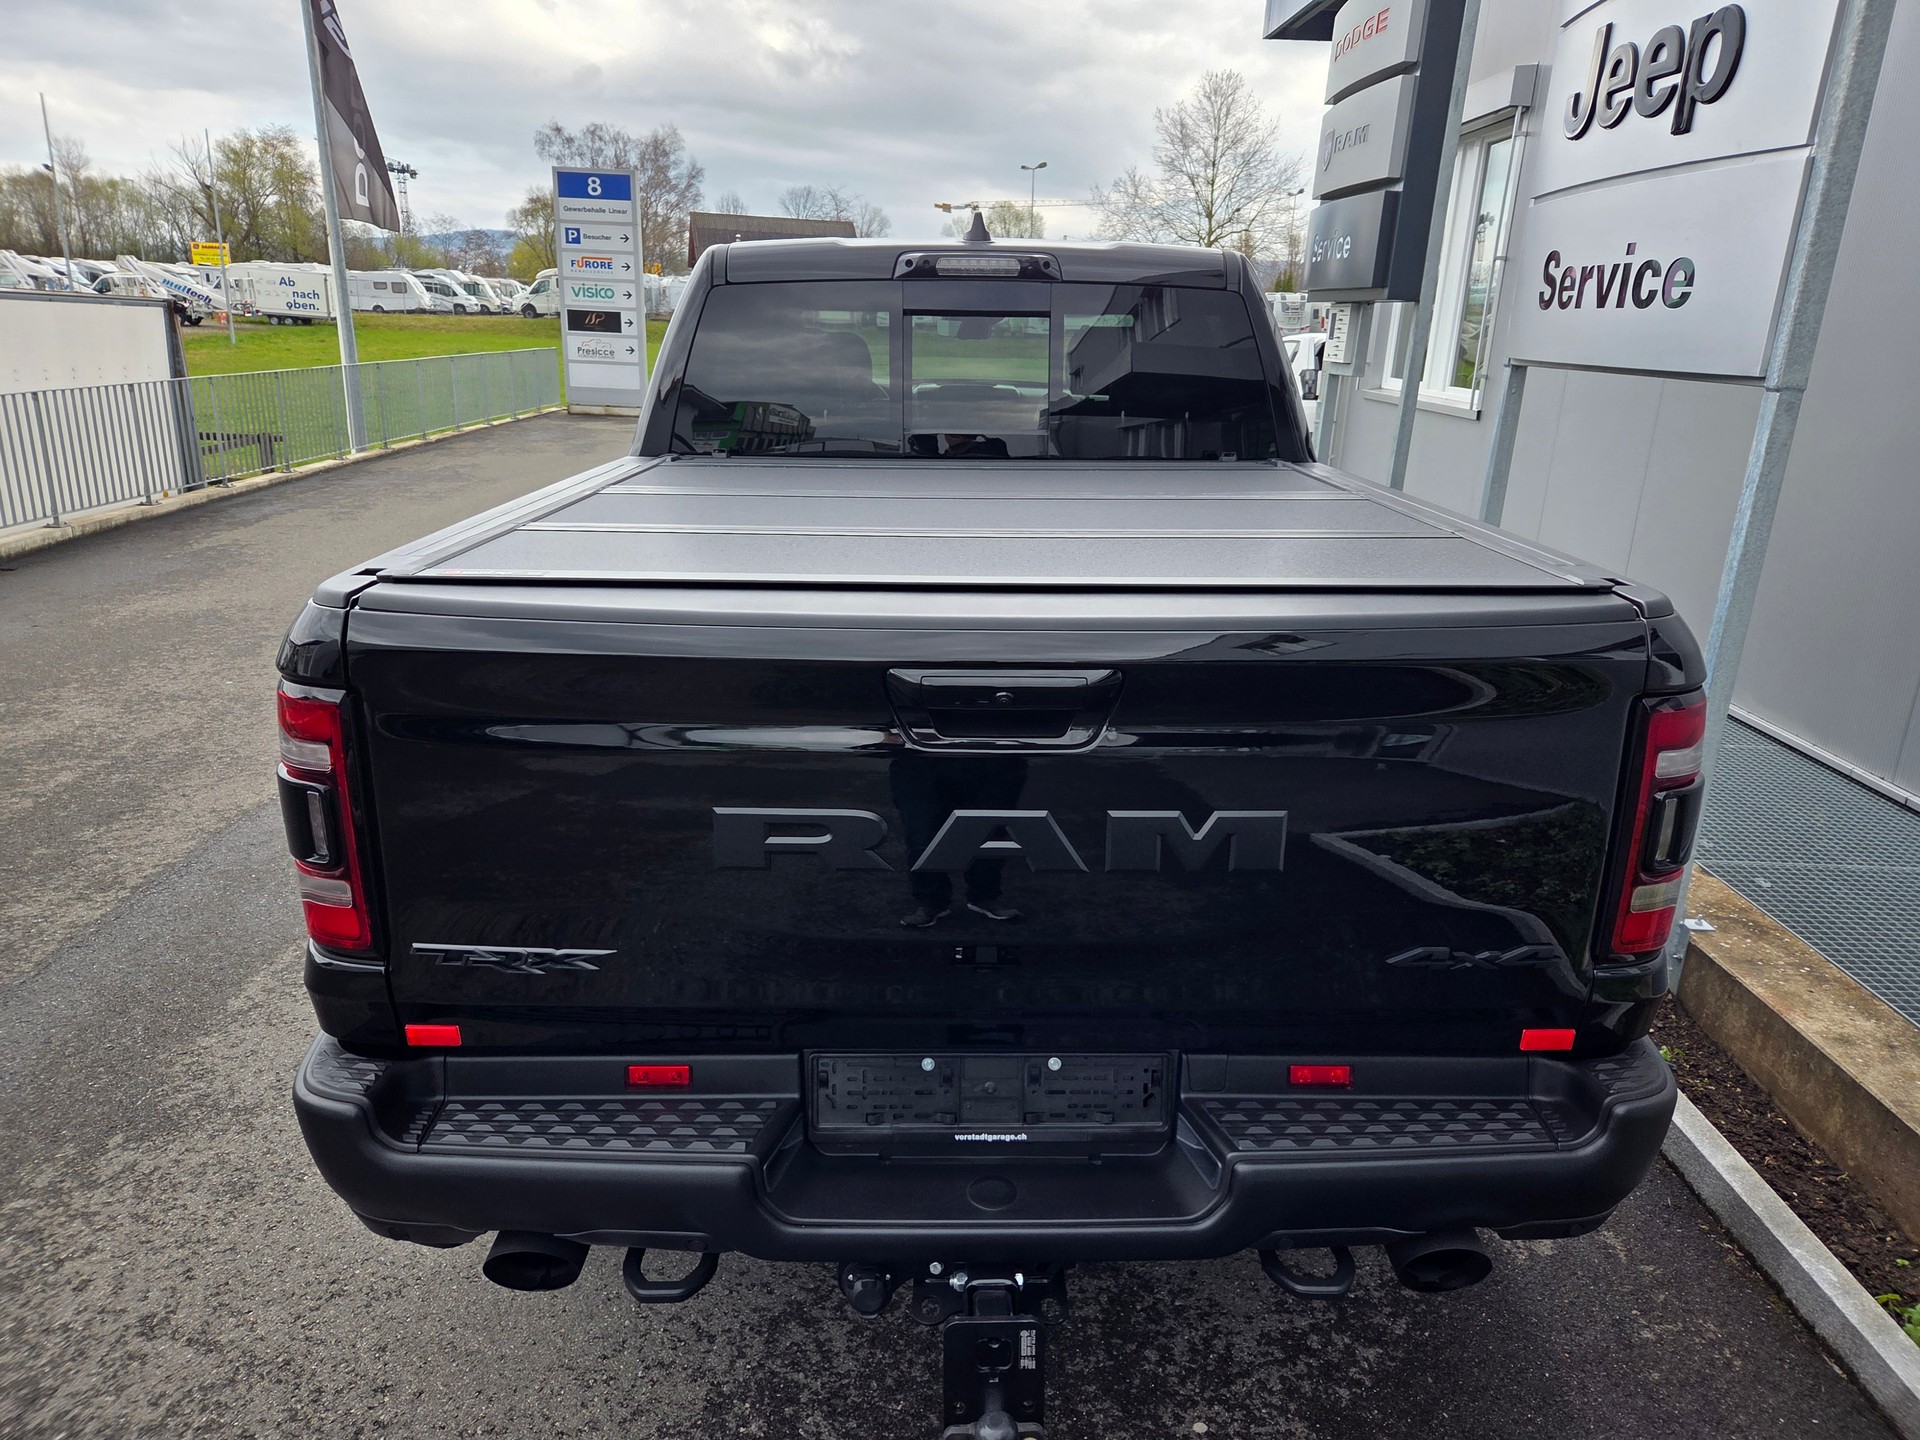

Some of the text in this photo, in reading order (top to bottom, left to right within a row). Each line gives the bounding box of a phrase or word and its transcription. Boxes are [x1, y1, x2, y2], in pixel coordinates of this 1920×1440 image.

[1334, 7, 1390, 62] DODGE
[1564, 3, 1747, 141] Jeep
[1334, 123, 1371, 153] RAM
[587, 176, 602, 196] 8
[563, 205, 628, 215] Gewerbehalle Linear
[568, 229, 578, 242] P
[583, 233, 612, 241] Besucher
[1311, 229, 1351, 263] Service
[570, 256, 613, 270] FURORE
[278, 276, 296, 287] Ab
[1539, 242, 1695, 310] Service
[161, 278, 213, 305] maltech
[292, 289, 320, 300] nach
[712, 807, 1289, 872] RAM
[954, 1133, 1028, 1142] vorstadtgarage.ch
